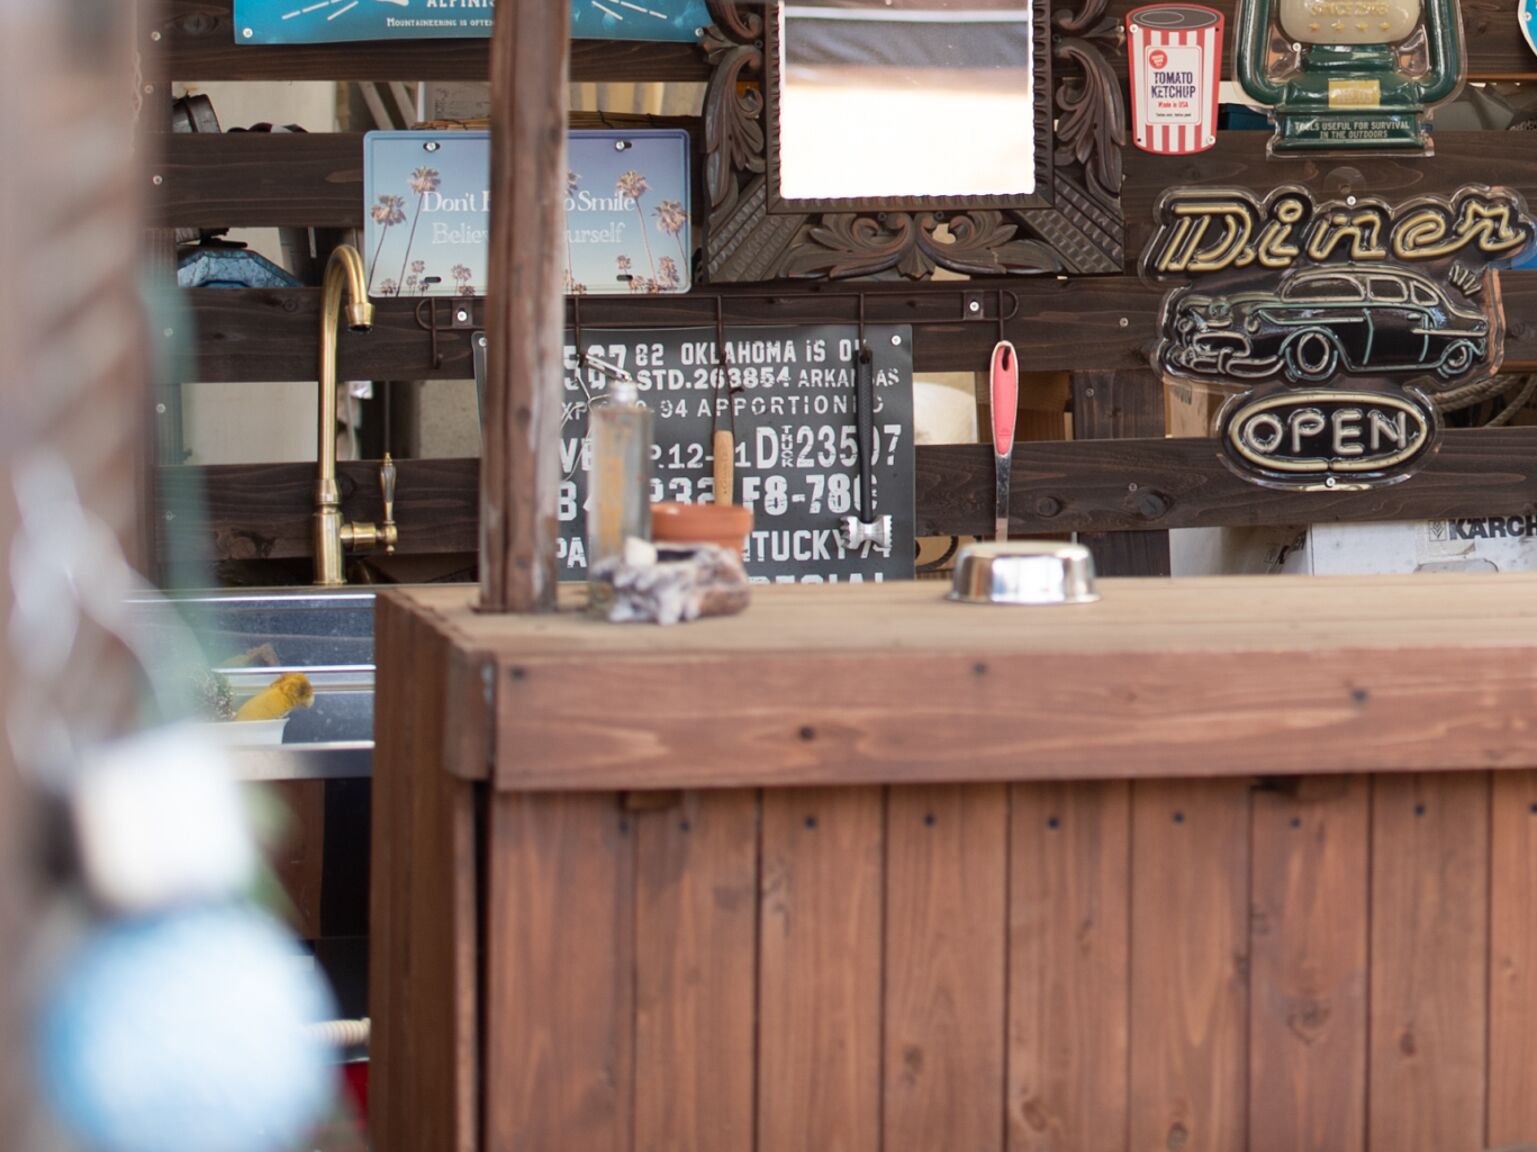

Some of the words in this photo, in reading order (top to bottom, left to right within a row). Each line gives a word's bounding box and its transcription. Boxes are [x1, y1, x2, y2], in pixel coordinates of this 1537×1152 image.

[1154, 71, 1193, 85] TOMATO
[1151, 85, 1196, 98] KETCHUP
[1320, 130, 1329, 139] IN
[1331, 130, 1346, 139] THE
[1349, 130, 1388, 139] OUTDOORS
[1321, 121, 1351, 131] USEFUL
[1353, 121, 1369, 130] FOR
[1371, 121, 1410, 130] SURVIVAL
[424, 190, 475, 213] Don't
[577, 191, 635, 213] Smile
[432, 222, 488, 244] Belie
[568, 222, 626, 244] urself
[1158, 200, 1526, 271] Diner
[681, 341, 796, 366] OKLAHOMA
[798, 367, 900, 388] ARKAAS
[697, 395, 884, 419] APPORTION
[1245, 408, 1408, 454] OPEN
